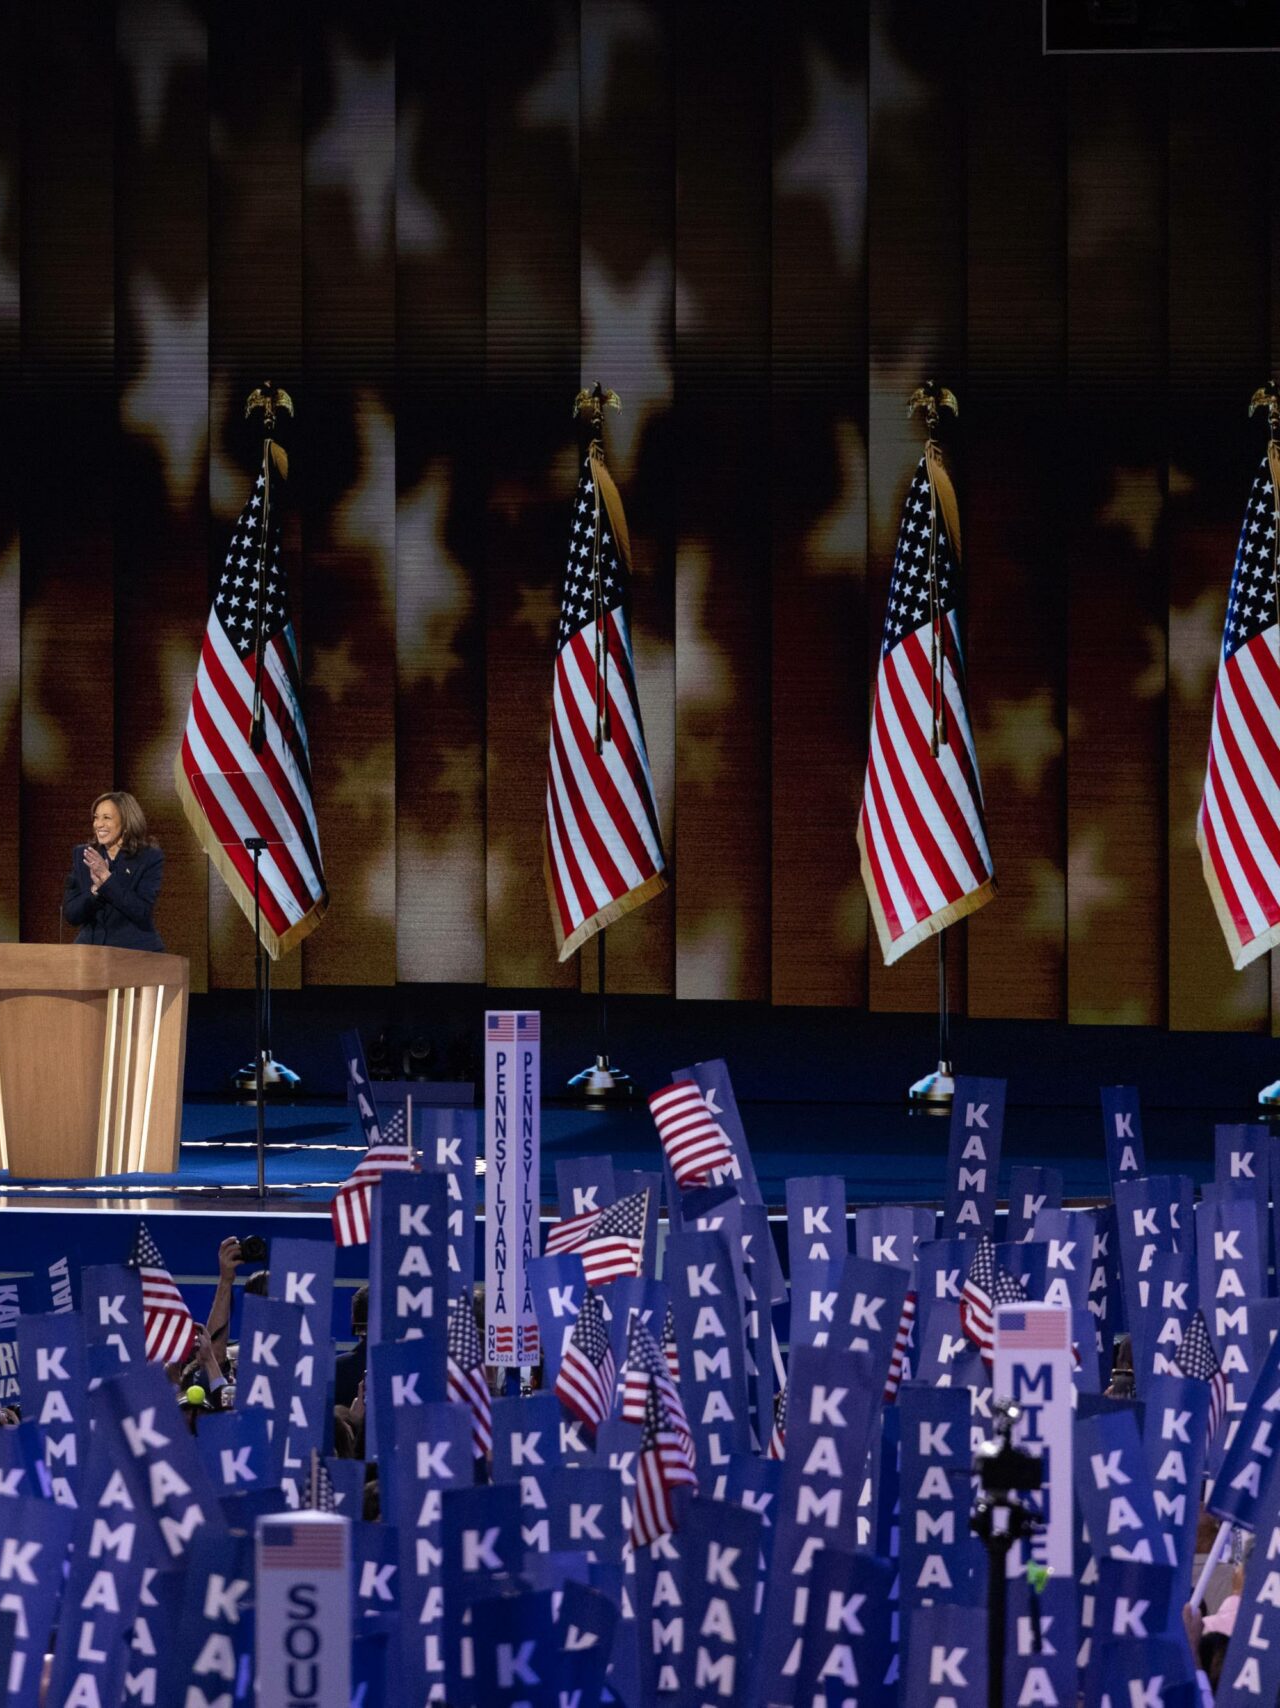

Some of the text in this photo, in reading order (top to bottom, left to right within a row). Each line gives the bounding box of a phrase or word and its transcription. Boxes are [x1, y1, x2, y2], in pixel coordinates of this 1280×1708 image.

[349, 1059, 381, 1144] KAM
[956, 1103, 989, 1225] KAMA
[495, 1052, 508, 1314] PENNSYLVANIA
[397, 1204, 434, 1341] KAM
[488, 1325, 496, 1361] DNC
[1153, 1281, 1188, 1378] KAM
[36, 1347, 79, 1509] KAMA
[122, 1408, 206, 1557] KAM
[511, 1432, 550, 1553] KAM
[1153, 1408, 1191, 1567] KAM
[915, 1422, 956, 1606] KAMA
[1090, 1450, 1152, 1564] KAM
[65, 1469, 137, 1708] AMALA
[284, 1584, 320, 1708] SOU
[651, 1534, 683, 1691] KAMA
[695, 1541, 741, 1697] KAM
